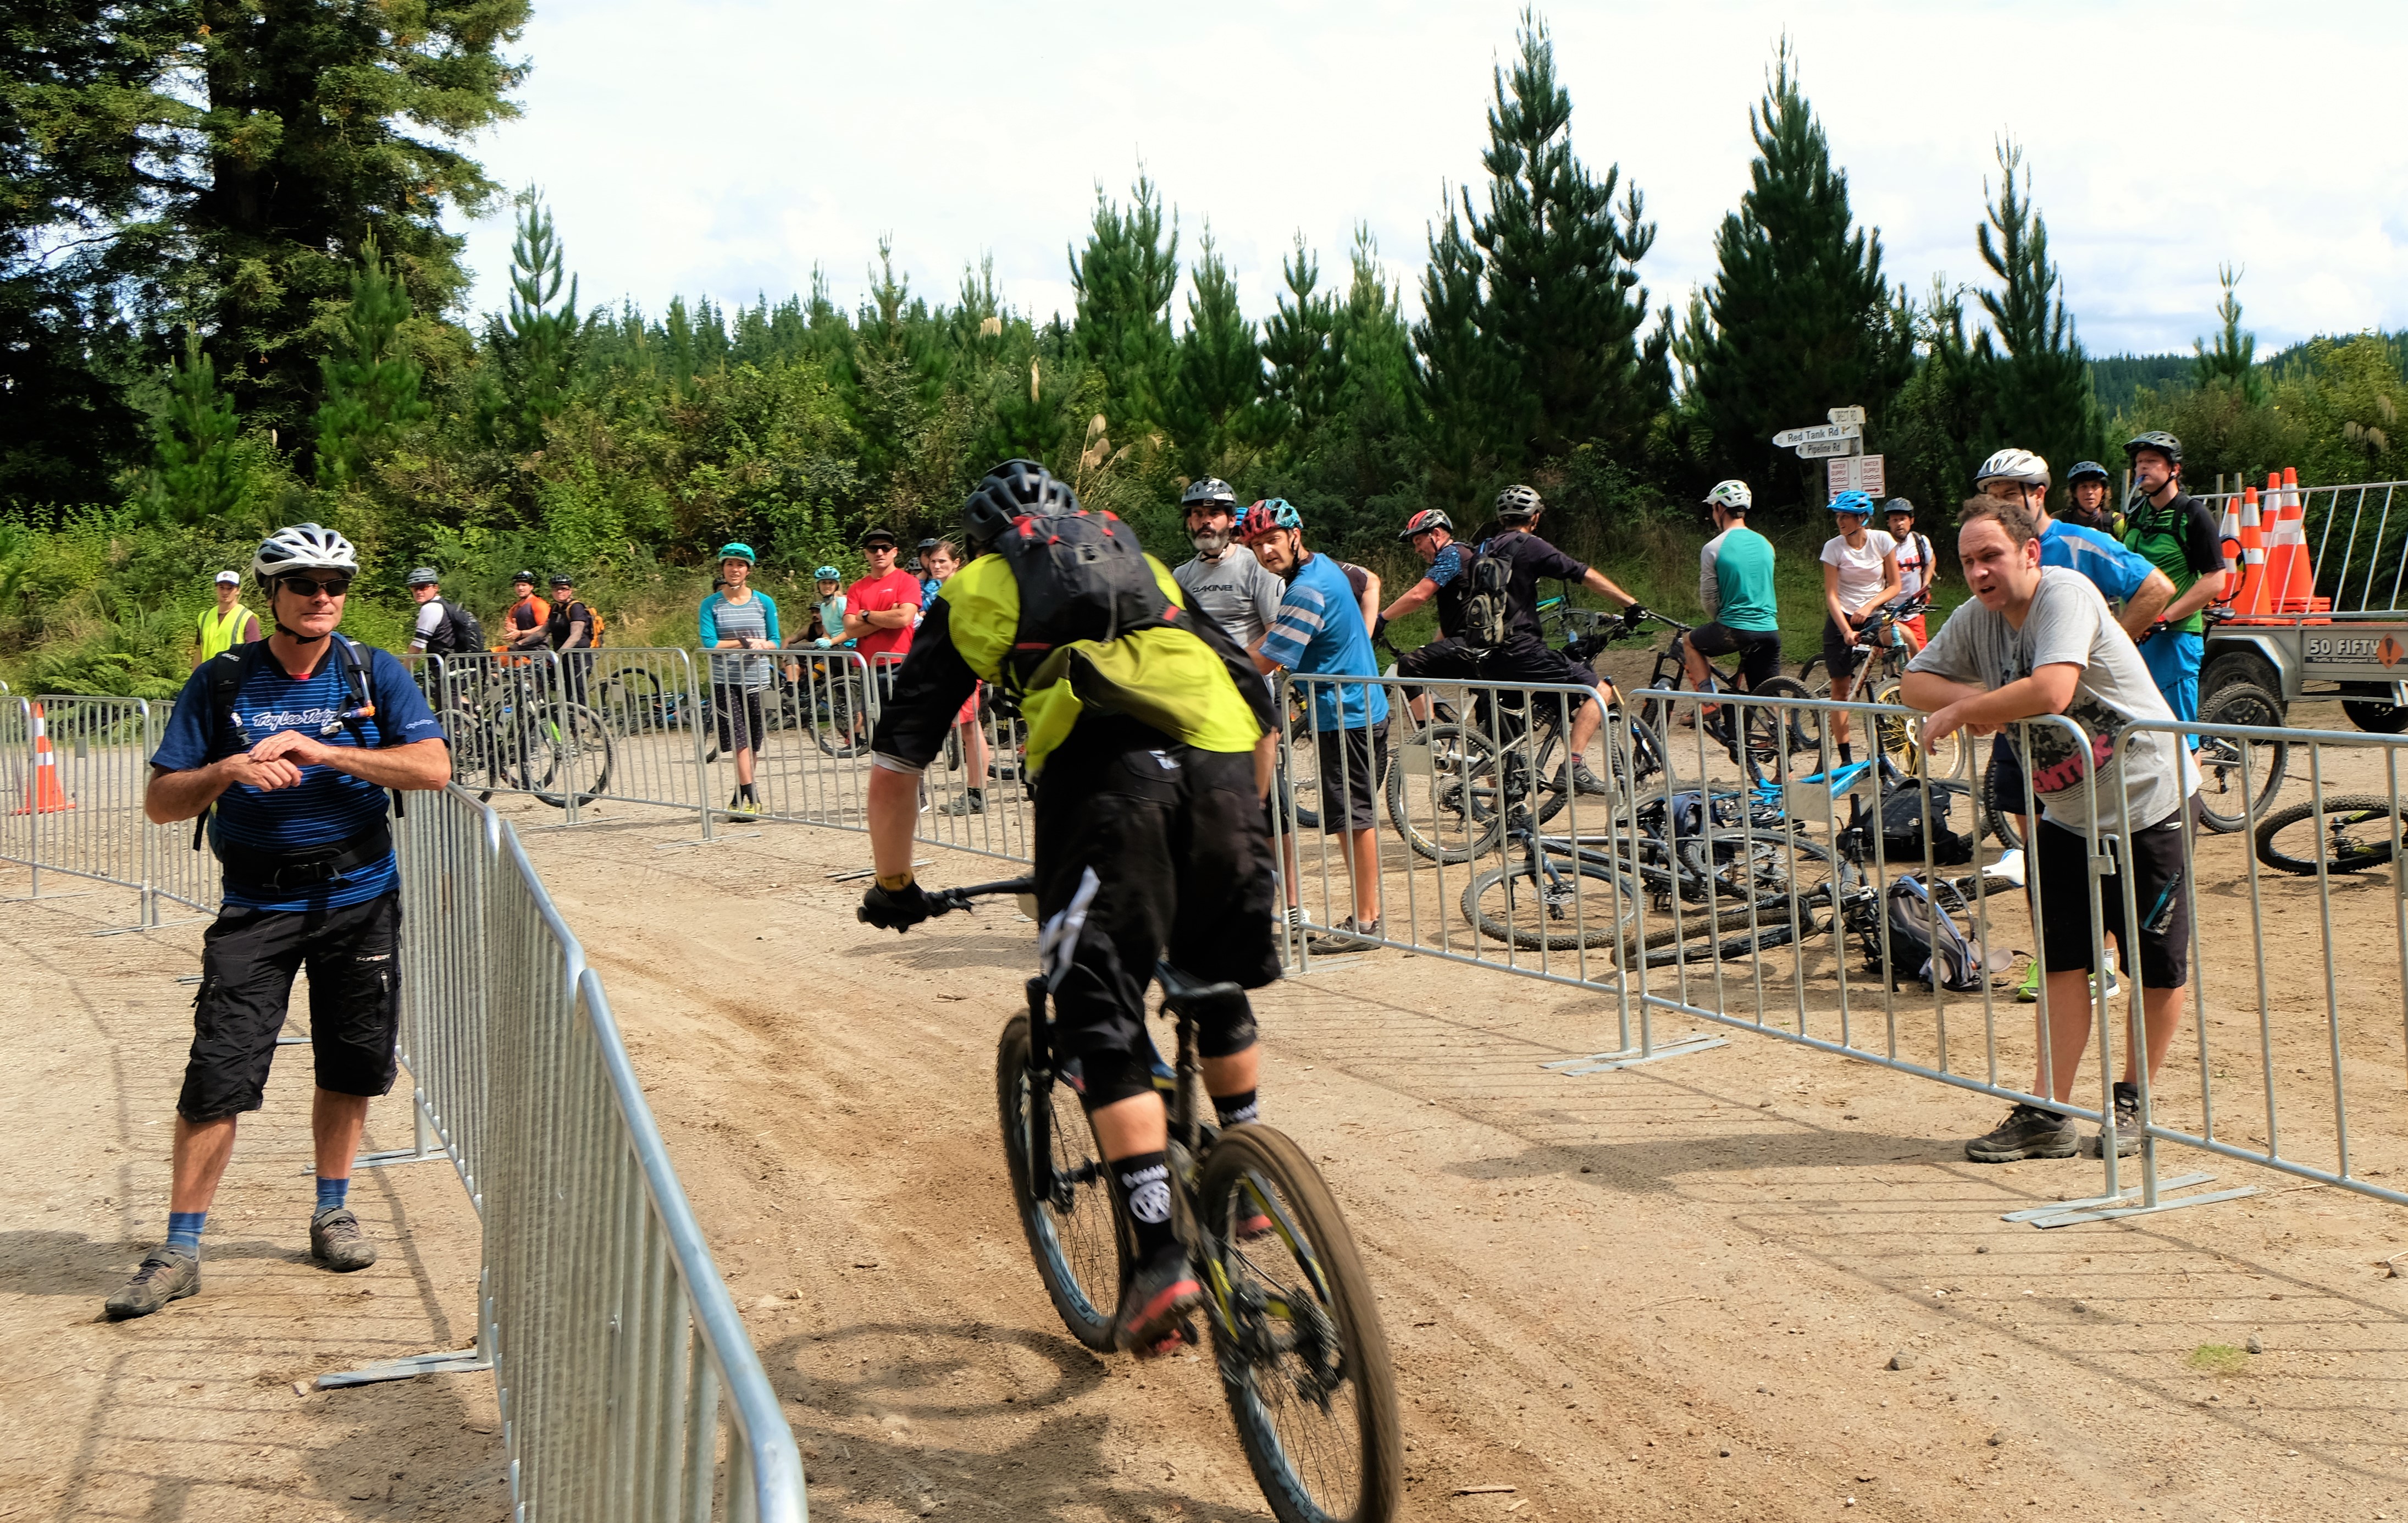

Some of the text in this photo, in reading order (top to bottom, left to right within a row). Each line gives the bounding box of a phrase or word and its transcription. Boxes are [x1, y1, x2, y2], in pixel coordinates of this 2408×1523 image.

[1787, 427, 1839, 443] Red Tank Rd
[1807, 443, 1841, 455] Pipeline Rd
[2310, 638, 2381, 655] 50 FIFTY
[252, 711, 280, 731] Troy
[280, 710, 303, 725] Lee
